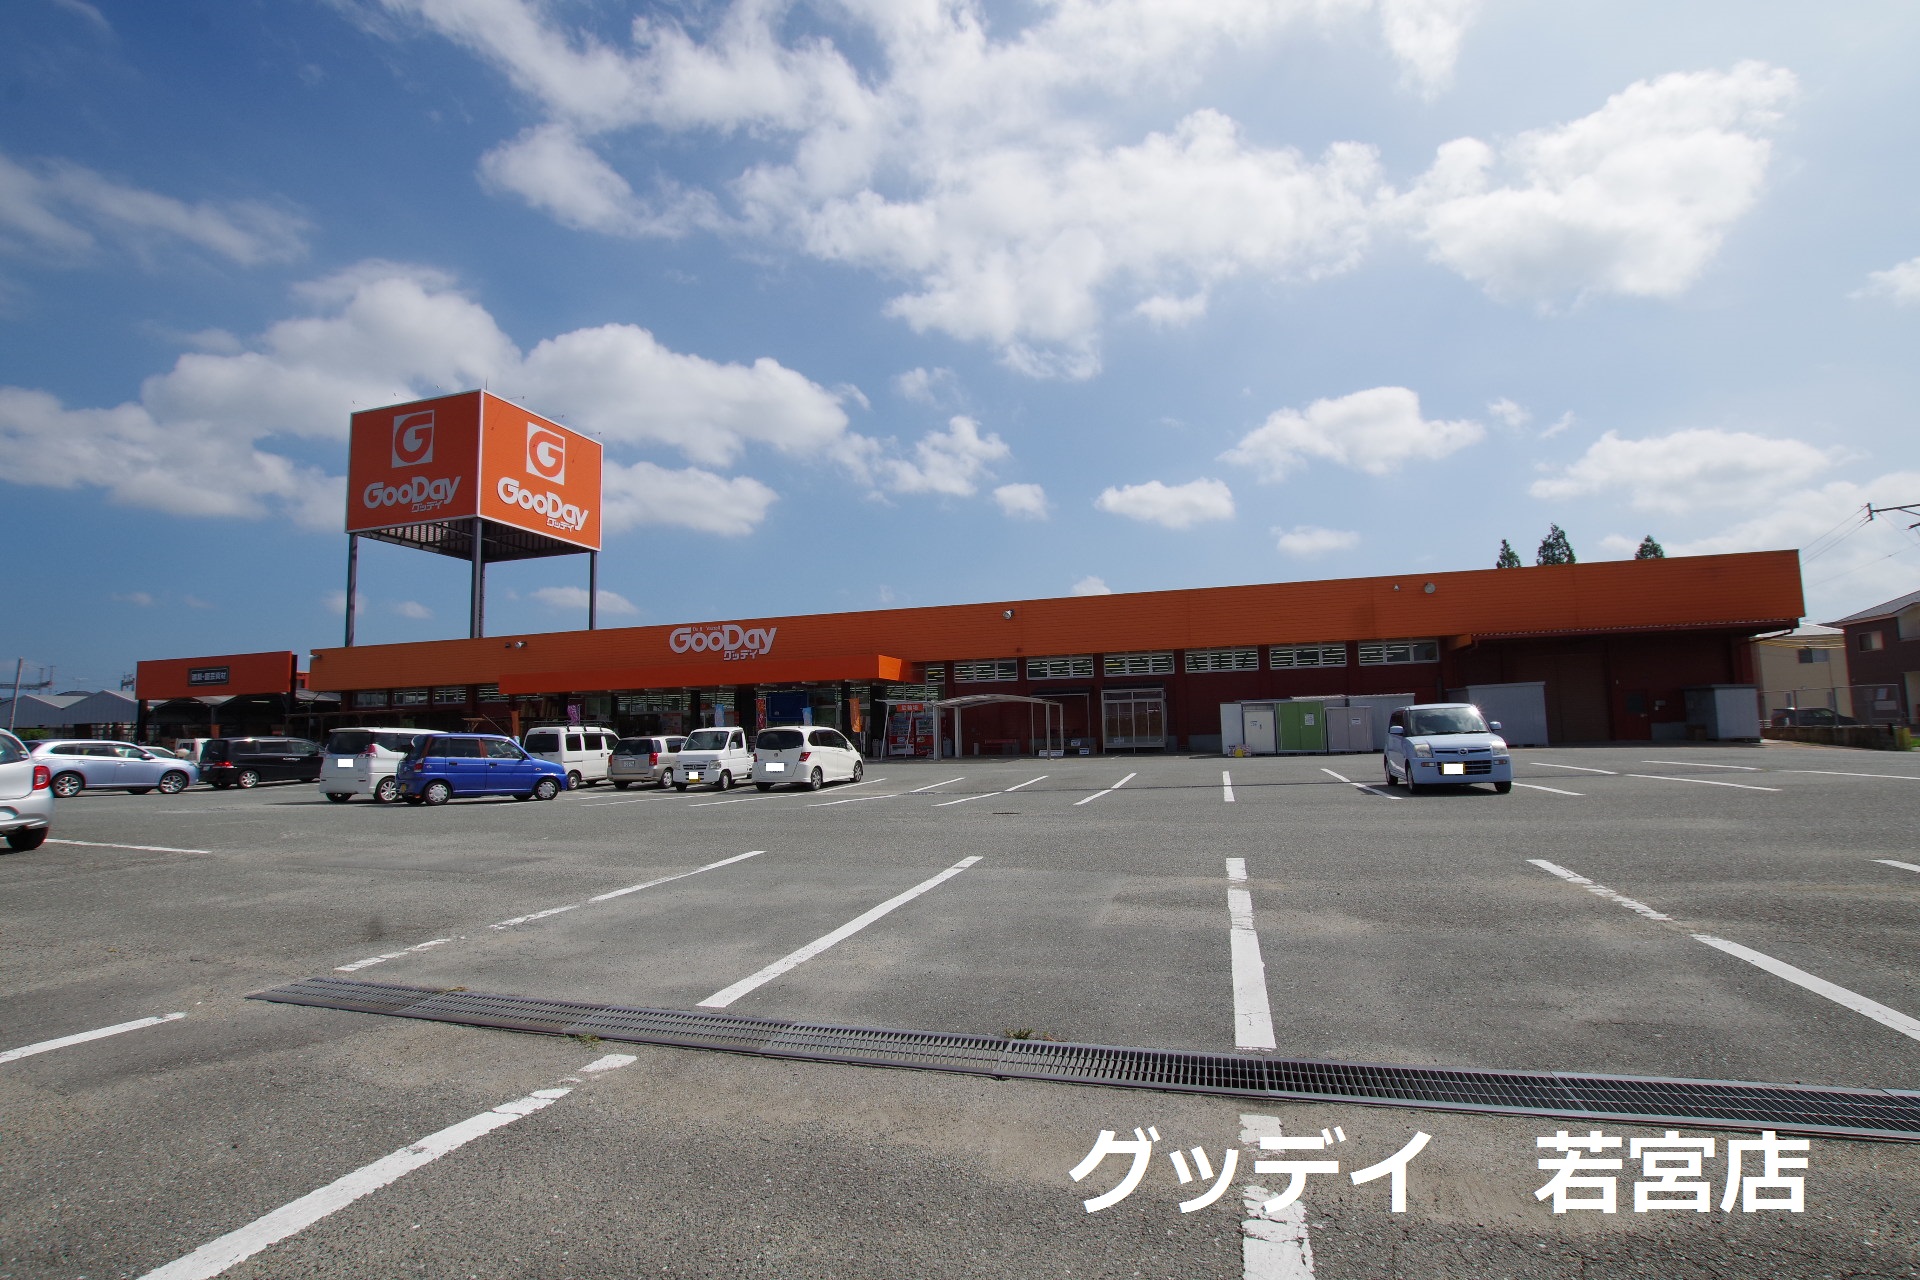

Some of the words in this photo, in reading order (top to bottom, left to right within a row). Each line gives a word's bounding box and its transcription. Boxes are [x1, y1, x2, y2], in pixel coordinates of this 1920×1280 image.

[363, 475, 462, 509] GooDay
[497, 476, 589, 531] GooDay
[669, 624, 778, 654] GooDay
[723, 649, 758, 661] グッデイ
